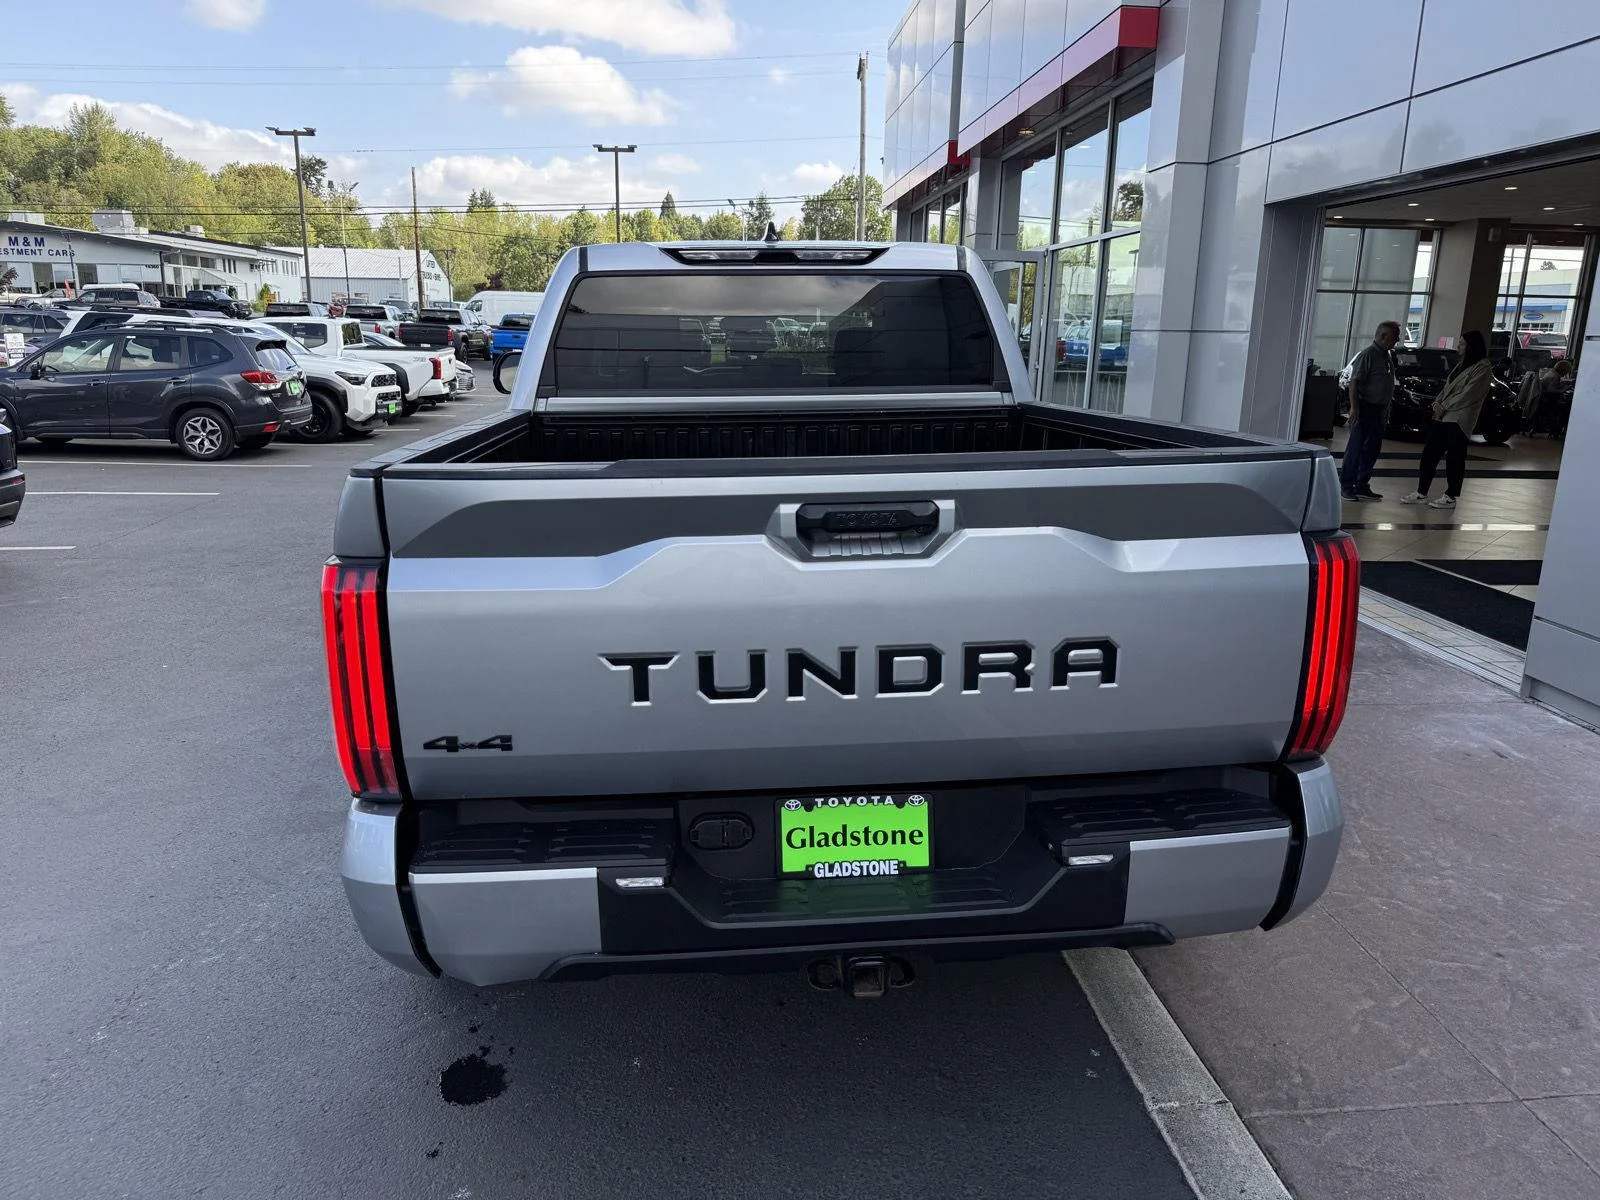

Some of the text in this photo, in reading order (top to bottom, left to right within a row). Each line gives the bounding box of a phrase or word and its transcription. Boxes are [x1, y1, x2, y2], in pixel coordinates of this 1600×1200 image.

[8, 236, 45, 247] M & M
[47, 248, 76, 257] CARS
[835, 512, 898, 528] TOYOTA
[597, 636, 1120, 706] TUNDRA
[814, 795, 895, 808] TOYOTA
[785, 823, 924, 850] Gladstone
[813, 859, 900, 879] GLADSTONE
